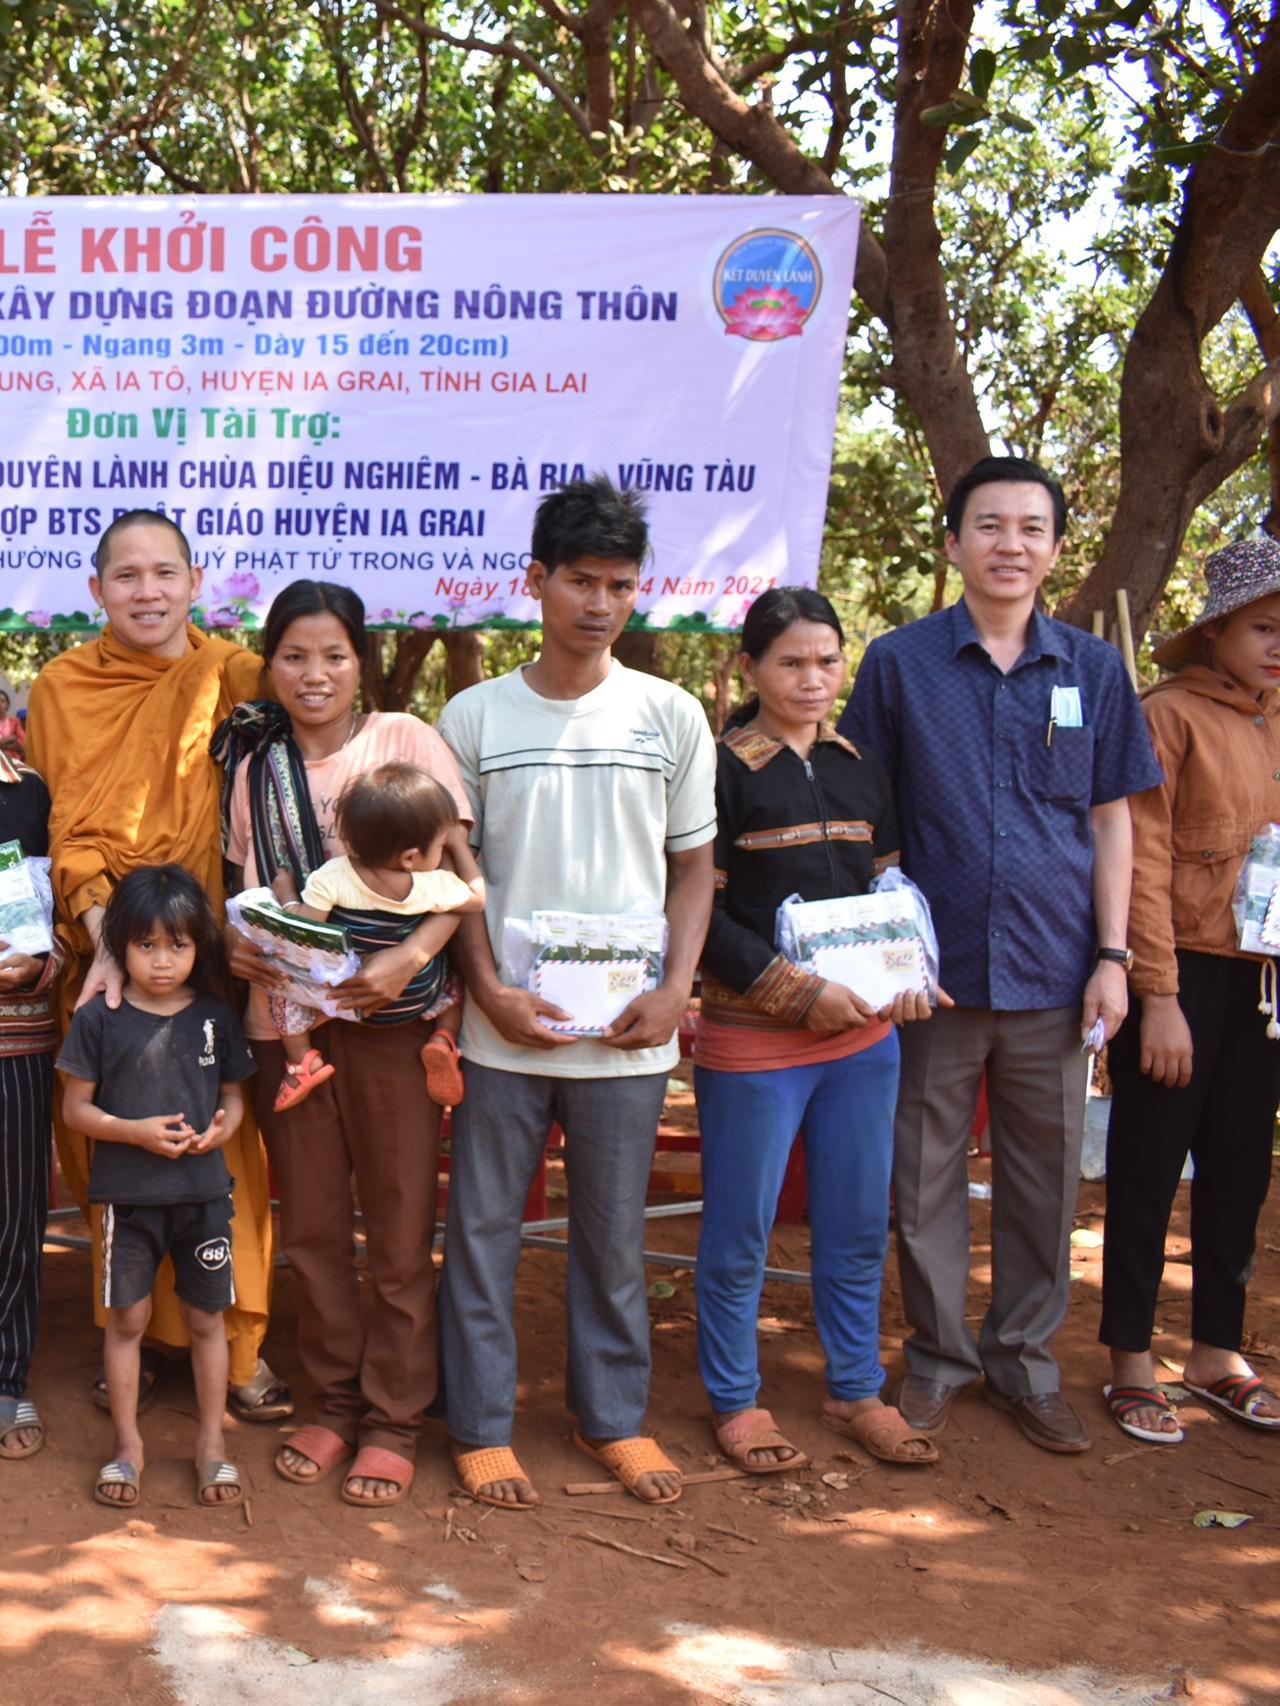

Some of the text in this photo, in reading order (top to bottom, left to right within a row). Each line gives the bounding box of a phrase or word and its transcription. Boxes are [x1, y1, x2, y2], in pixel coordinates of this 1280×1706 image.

[81, 210, 225, 273] KHỞI
[251, 215, 422, 272] CÔNG
[69, 287, 173, 326] DỰNG
[186, 289, 293, 326] ĐOẠN
[306, 282, 440, 319] ĐƯỜNG
[454, 283, 563, 320] NÔNG
[576, 285, 678, 321] THÔN
[83, 335, 171, 358] Ngang
[181, 334, 224, 356] 3m
[255, 334, 305, 358] Dày
[317, 334, 349, 355] 15
[359, 329, 409, 356] đến
[420, 334, 509, 358] 20cm)
[71, 366, 107, 392] XÃ
[116, 371, 141, 392] IA
[149, 365, 192, 394] TÔ,
[201, 370, 294, 396] HUYỆN
[304, 371, 329, 392] IA
[337, 371, 410, 394] GRAI,
[491, 372, 536, 393] GIA
[546, 373, 587, 393] LAI
[66, 406, 342, 447] Đơn Vị Tài Trợ:
[93, 454, 168, 489] LÀNH
[179, 454, 257, 490] CHÙA
[268, 454, 335, 496] DIỆU
[344, 454, 460, 490] NGHIÊM
[491, 456, 529, 491] BÀ
[618, 458, 694, 493] VŨNG
[704, 458, 757, 493] TÀU
[49, 508, 101, 536] BTS
[197, 502, 263, 536] GIÁO
[274, 502, 370, 543] HUYỆN
[381, 508, 408, 536] IA
[419, 508, 486, 537] GRAI
[195, 546, 225, 569] UÝ
[307, 547, 342, 570] TỬ
[349, 551, 434, 570] TRONG
[442, 546, 474, 570] VÀ
[483, 551, 533, 570] NGO
[434, 576, 499, 601] Ngày
[661, 575, 715, 596] Năm
